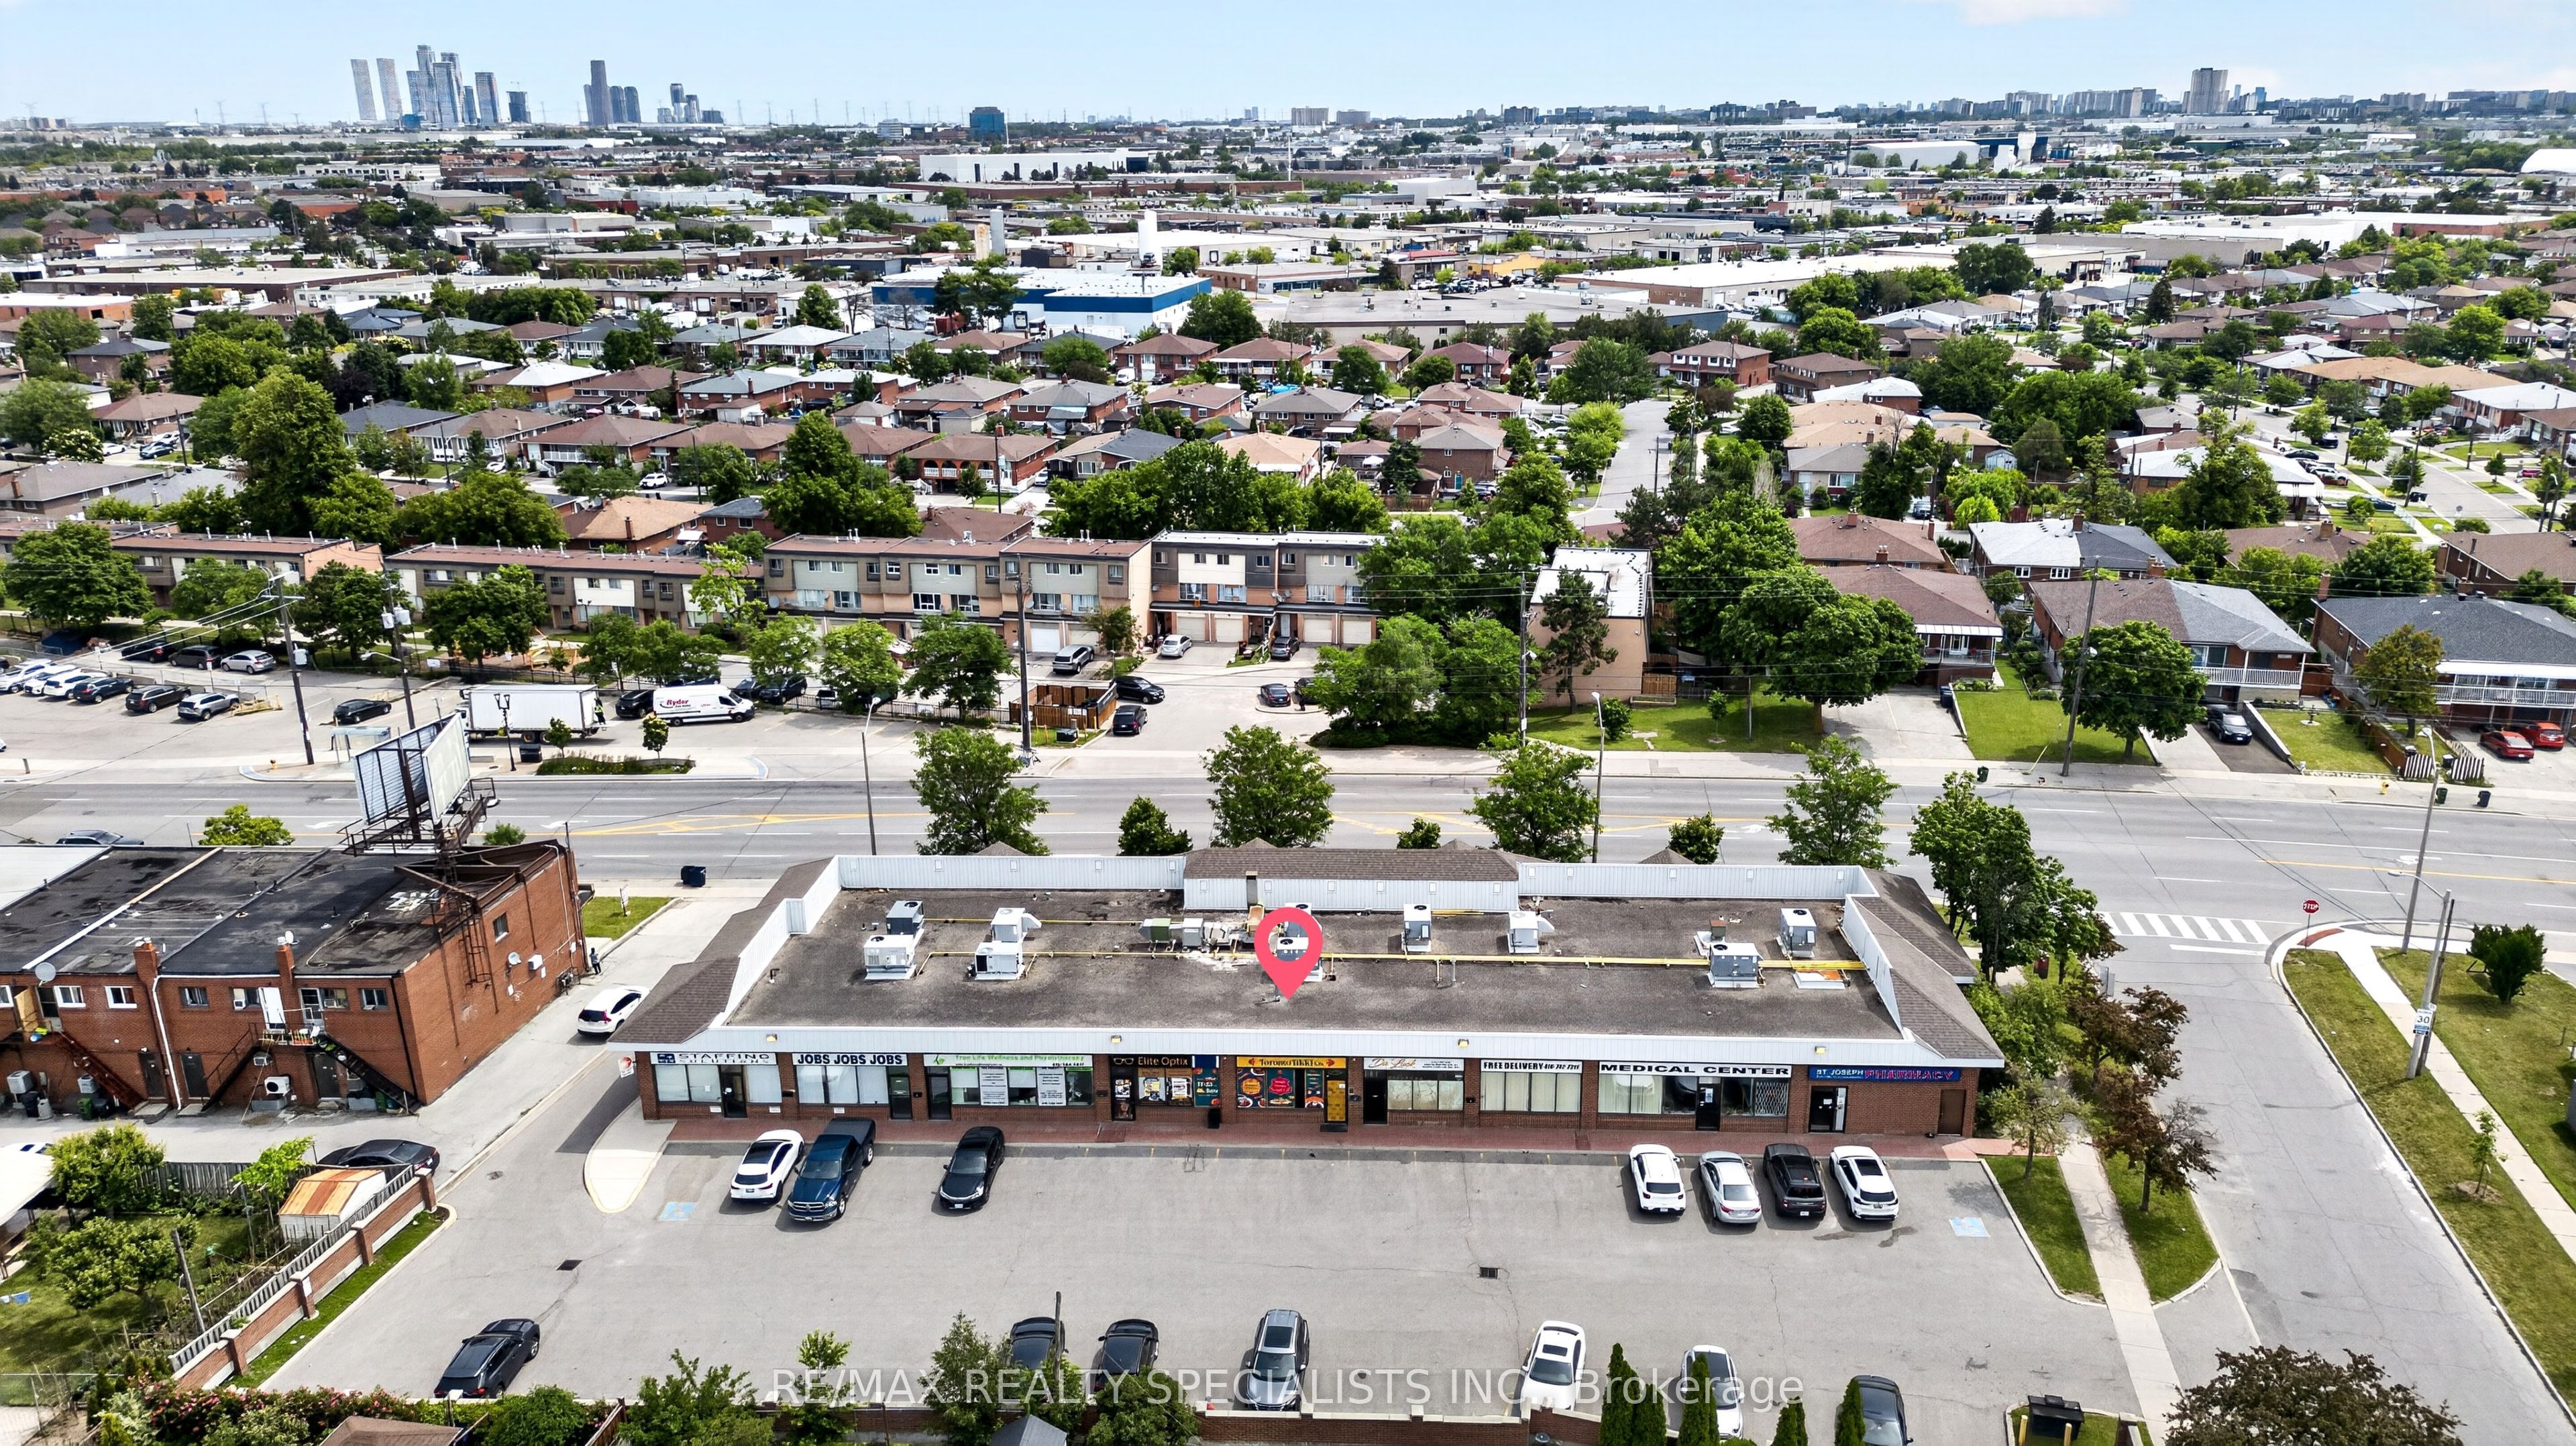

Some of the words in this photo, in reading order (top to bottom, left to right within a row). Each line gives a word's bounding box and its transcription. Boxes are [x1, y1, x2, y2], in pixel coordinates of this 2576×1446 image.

[2417, 1015, 2430, 1023] 30
[798, 1054, 830, 1064] JOBS
[834, 1054, 866, 1064] JOBS
[870, 1054, 902, 1065] JOBS
[1138, 1057, 1159, 1065] Elite
[1161, 1057, 1188, 1066] Optix
[1601, 1064, 1696, 1073] MEDICAL
[1703, 1066, 1789, 1074] CENTER
